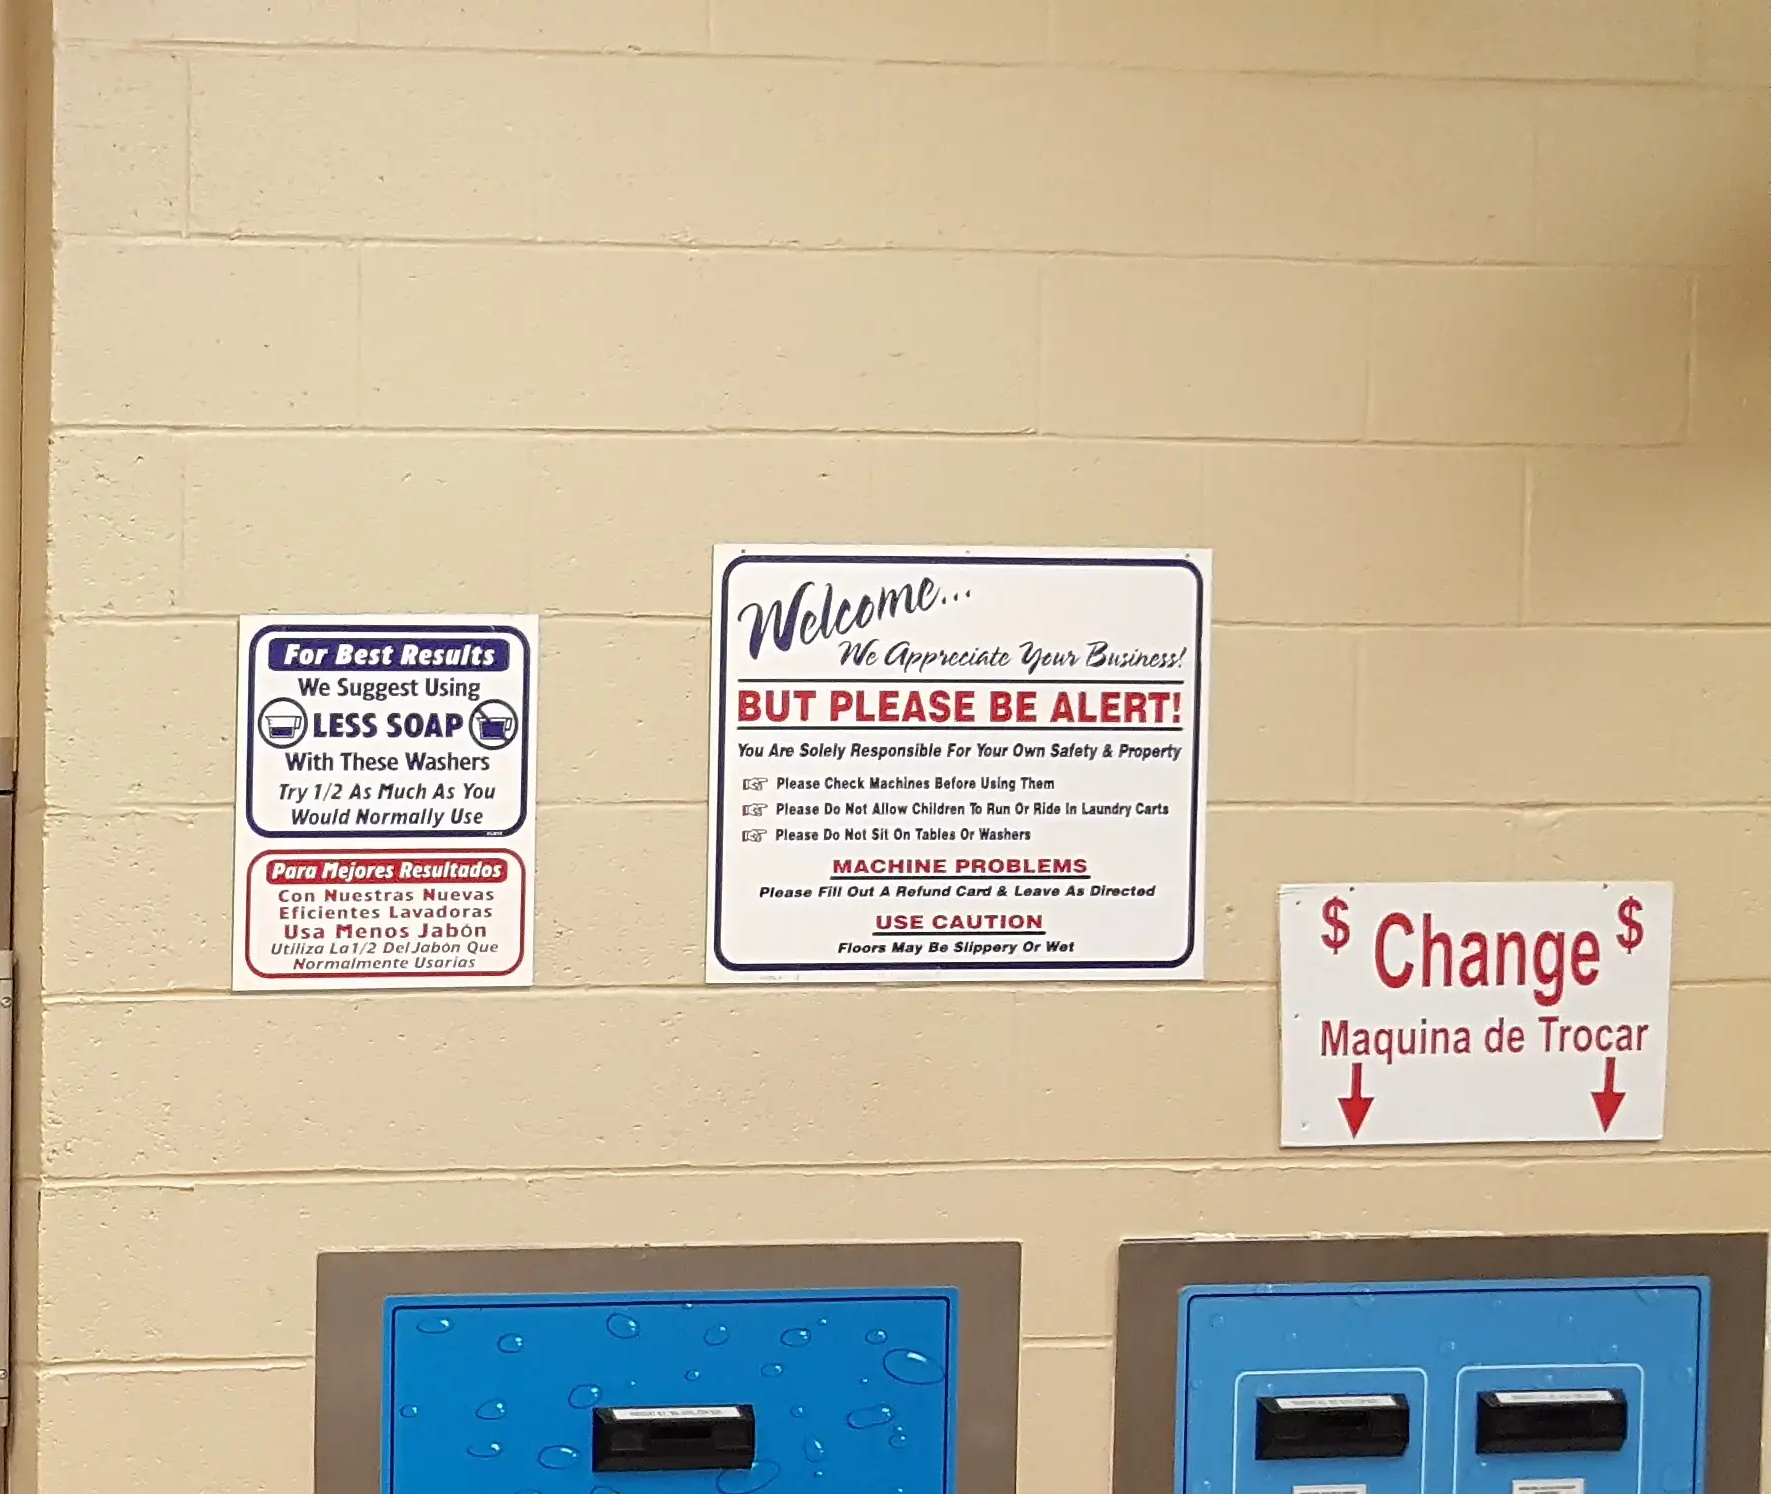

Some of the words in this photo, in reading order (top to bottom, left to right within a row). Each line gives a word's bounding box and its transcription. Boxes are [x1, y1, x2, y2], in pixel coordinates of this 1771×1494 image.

[284, 644, 328, 665] For
[335, 644, 393, 665] Best
[401, 644, 494, 665] Results
[839, 639, 879, 666] We
[884, 641, 1011, 673] Appreciate
[1019, 641, 1079, 675] Your
[1086, 641, 1187, 668] Business!
[298, 678, 330, 696] We
[337, 678, 418, 701] Suggest
[426, 677, 480, 701] Using
[738, 690, 816, 722] BUT
[830, 690, 975, 723] PLEASE
[990, 691, 1036, 722] BE
[1050, 692, 1180, 723] ALERT!
[314, 713, 377, 738] LESS
[387, 713, 463, 738] SOAP
[285, 752, 333, 771] With
[340, 752, 398, 771] These
[405, 752, 489, 771] Washers
[738, 743, 764, 757] You
[768, 743, 794, 757] Are
[799, 743, 846, 760] Solely
[850, 743, 941, 760] Responsible
[947, 743, 971, 757] For
[977, 743, 1008, 757] Your
[1013, 743, 1045, 757] Own
[1050, 743, 1098, 760] Safety
[1103, 744, 1113, 757] &
[1119, 744, 1182, 761] Property
[280, 784, 308, 803] Try
[315, 783, 342, 801] 1/2
[349, 783, 371, 799] As
[378, 783, 426, 799] Much
[432, 783, 455, 799] As
[464, 783, 495, 799] You
[777, 777, 820, 789] Please
[825, 777, 864, 789] Check
[870, 777, 930, 789] Machines
[935, 776, 976, 789] Before
[981, 777, 1015, 792] Using
[1020, 777, 1054, 789] Them
[292, 809, 350, 825] Would
[356, 808, 445, 828] Normally
[451, 808, 483, 824] Use
[776, 803, 819, 815] Please
[825, 803, 840, 815] Do
[846, 803, 867, 815] Not
[872, 802, 908, 815] Allow
[912, 802, 964, 815] Children
[970, 802, 982, 815] To
[987, 803, 1010, 815] Run
[1015, 802, 1029, 815] Or
[1034, 802, 1061, 815] Ride
[1066, 803, 1077, 814] In
[1082, 802, 1131, 817] Laundry
[1136, 802, 1168, 815] Carts
[271, 861, 317, 880] Para
[322, 862, 394, 882] Mejores
[399, 861, 503, 880] Resultados
[834, 859, 946, 873] MACHINE
[956, 859, 1087, 873] PROBLEMS
[279, 890, 314, 902] Con
[325, 889, 413, 902] Nuestras
[423, 889, 494, 901] Nuevas
[390, 905, 492, 918] Lavadoras
[285, 925, 324, 939] Usa
[336, 924, 409, 938] Menos
[418, 923, 486, 938] Jabón
[877, 915, 923, 929] USE
[932, 915, 1042, 929] CAUTION
[838, 943, 886, 953] Floors
[892, 942, 922, 955] May
[928, 942, 948, 952] Be
[954, 941, 1018, 955] Slippery
[1023, 941, 1041, 952] Or
[1047, 941, 1074, 952] Wet
[1375, 912, 1600, 1007] Change
[1321, 1018, 1470, 1065] Maquina
[1485, 1017, 1524, 1053] de
[1538, 1016, 1649, 1052] Trocar
